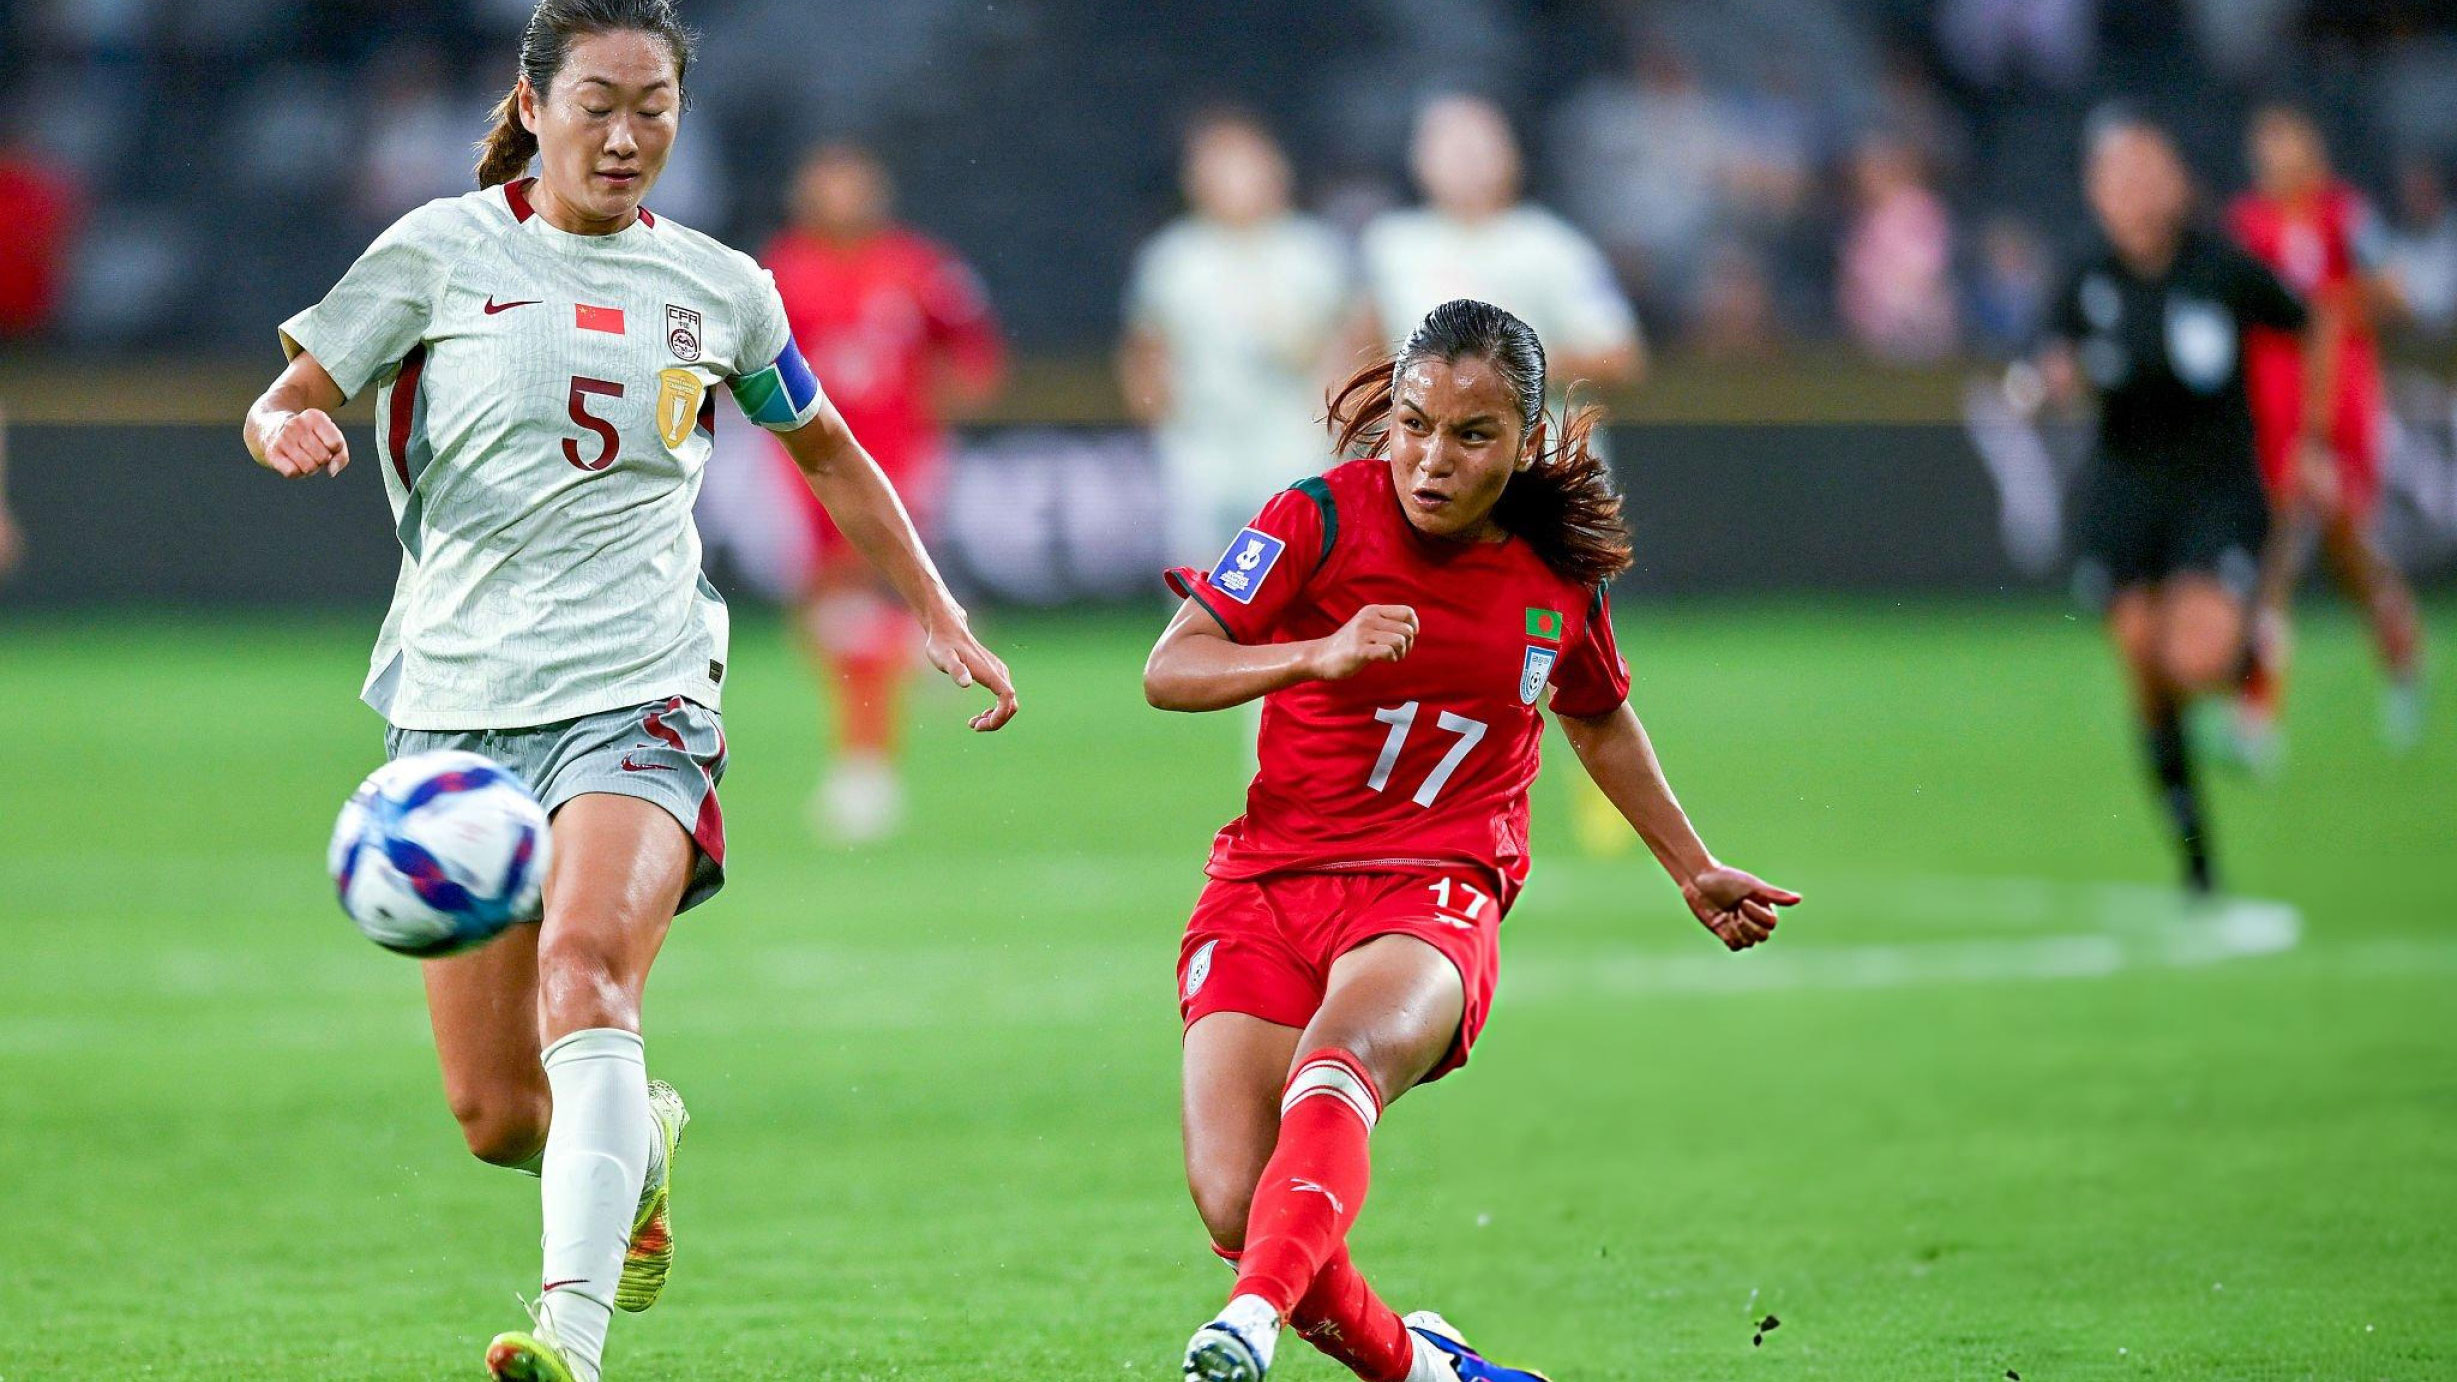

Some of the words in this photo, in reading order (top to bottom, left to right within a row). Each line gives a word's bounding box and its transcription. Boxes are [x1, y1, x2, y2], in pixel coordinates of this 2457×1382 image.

[669, 308, 698, 325] CFA
[562, 375, 625, 471] 5
[1367, 700, 1488, 808] 17
[1428, 876, 1489, 919] 17
